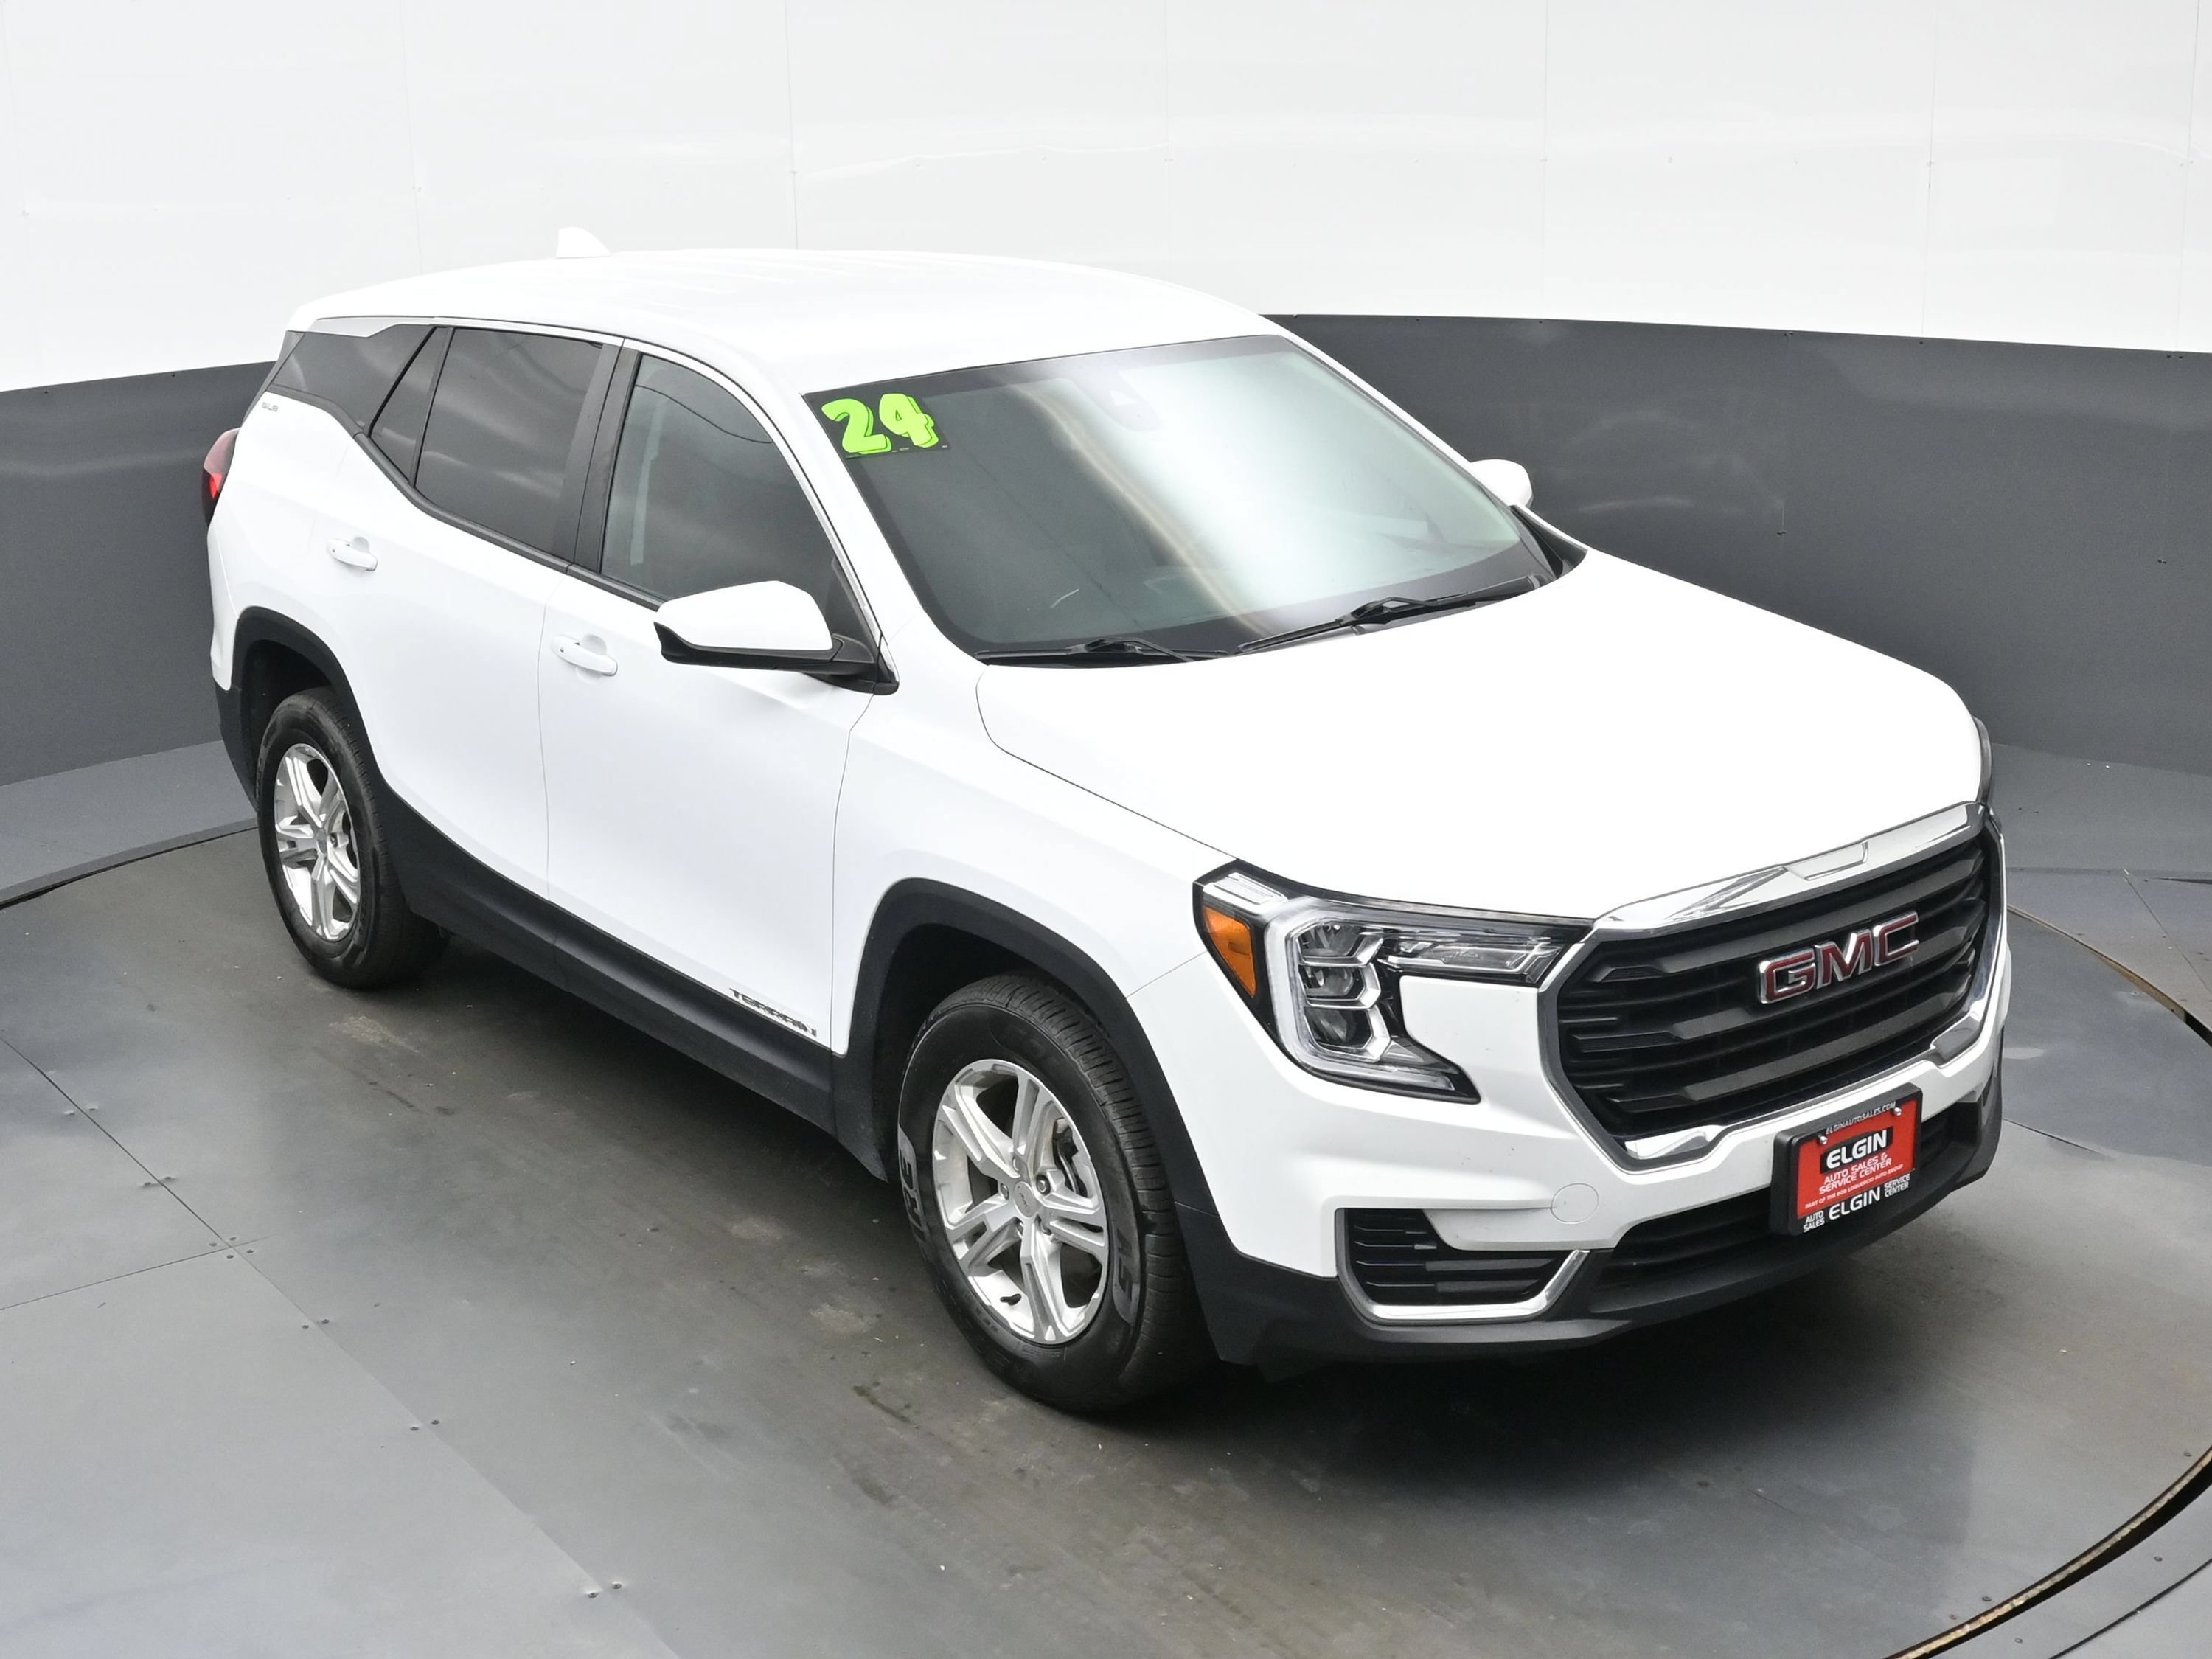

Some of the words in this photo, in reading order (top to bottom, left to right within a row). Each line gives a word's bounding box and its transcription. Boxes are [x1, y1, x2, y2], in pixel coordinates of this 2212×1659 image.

[821, 393, 939, 454] 24
[1758, 911, 1919, 1004] GMC
[1826, 1101, 1896, 1134] ELGINAUTOSALES.COM
[1826, 1130, 1887, 1169] ELGIN
[1819, 1172, 1857, 1194] SERVICE
[1859, 1158, 1892, 1178] CENTER
[1824, 1169, 1848, 1185] AUTO
[1851, 1155, 1879, 1172] SALES
[1884, 1173, 1910, 1190] SERVICE
[1805, 1200, 1818, 1209] PART
[1829, 1186, 1881, 1220] ELGIN
[1884, 1181, 1909, 1197] CENTER
[1803, 1217, 1825, 1233] SALES
[1805, 1210, 1824, 1223] AUTO
